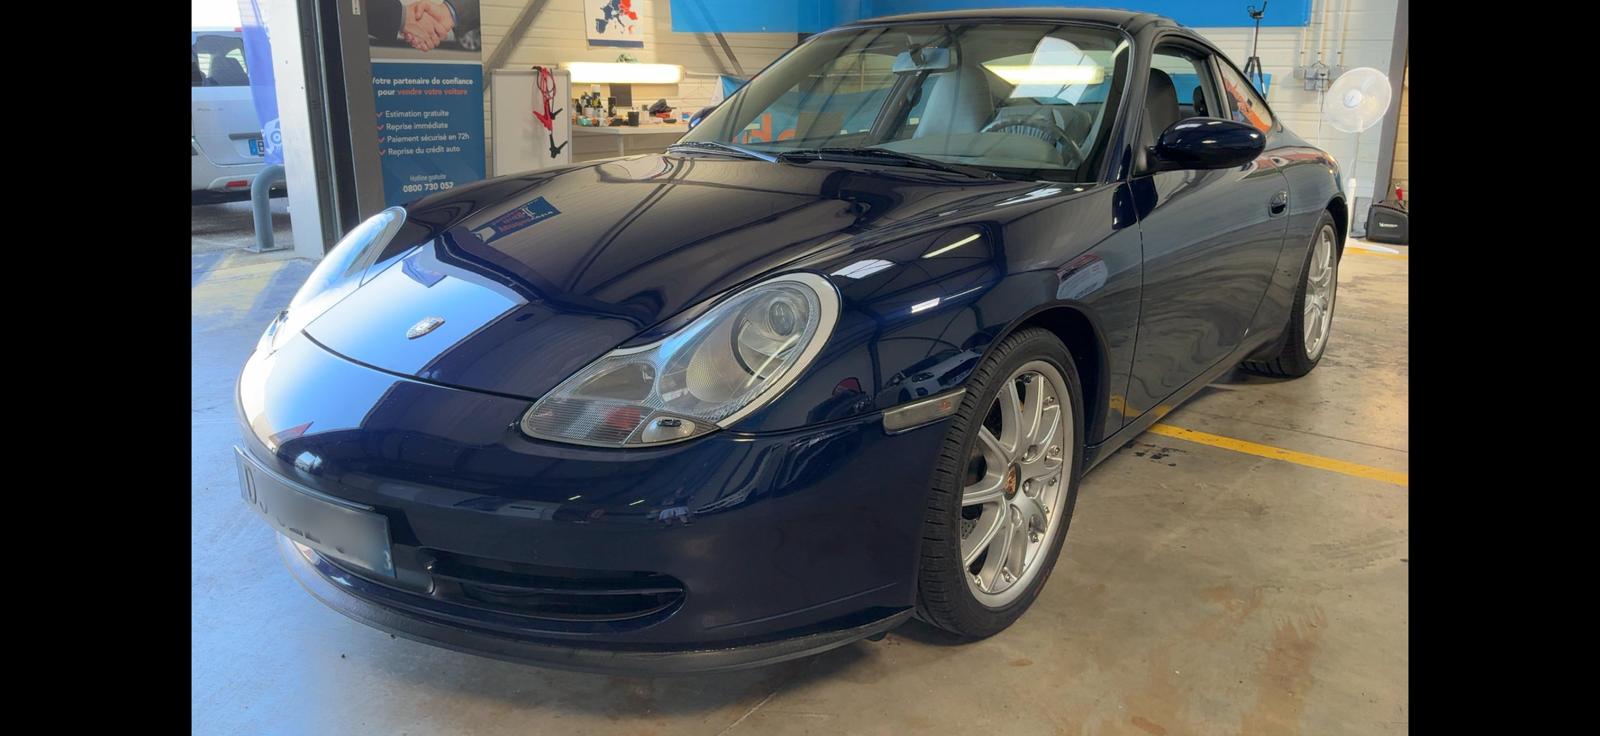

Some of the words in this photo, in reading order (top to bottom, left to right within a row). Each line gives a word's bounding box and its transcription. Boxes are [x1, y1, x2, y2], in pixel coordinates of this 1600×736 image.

[393, 77, 430, 86] partenaire
[431, 77, 441, 85] de
[442, 77, 474, 85] confiance
[377, 89, 396, 97] pour
[397, 87, 422, 95] vendre
[385, 110, 422, 118] Estimation
[423, 109, 450, 119] gratuite
[386, 122, 412, 132] Reprise
[413, 120, 449, 130] immédiate
[387, 134, 420, 143] Paiement
[420, 132, 447, 142] sécurisé
[457, 132, 470, 141] 72h
[388, 147, 414, 157] Reprise
[415, 145, 425, 154] du
[425, 144, 445, 153] crédit
[445, 145, 461, 153] auto
[403, 183, 423, 193] 0800
[424, 181, 439, 191] 730
